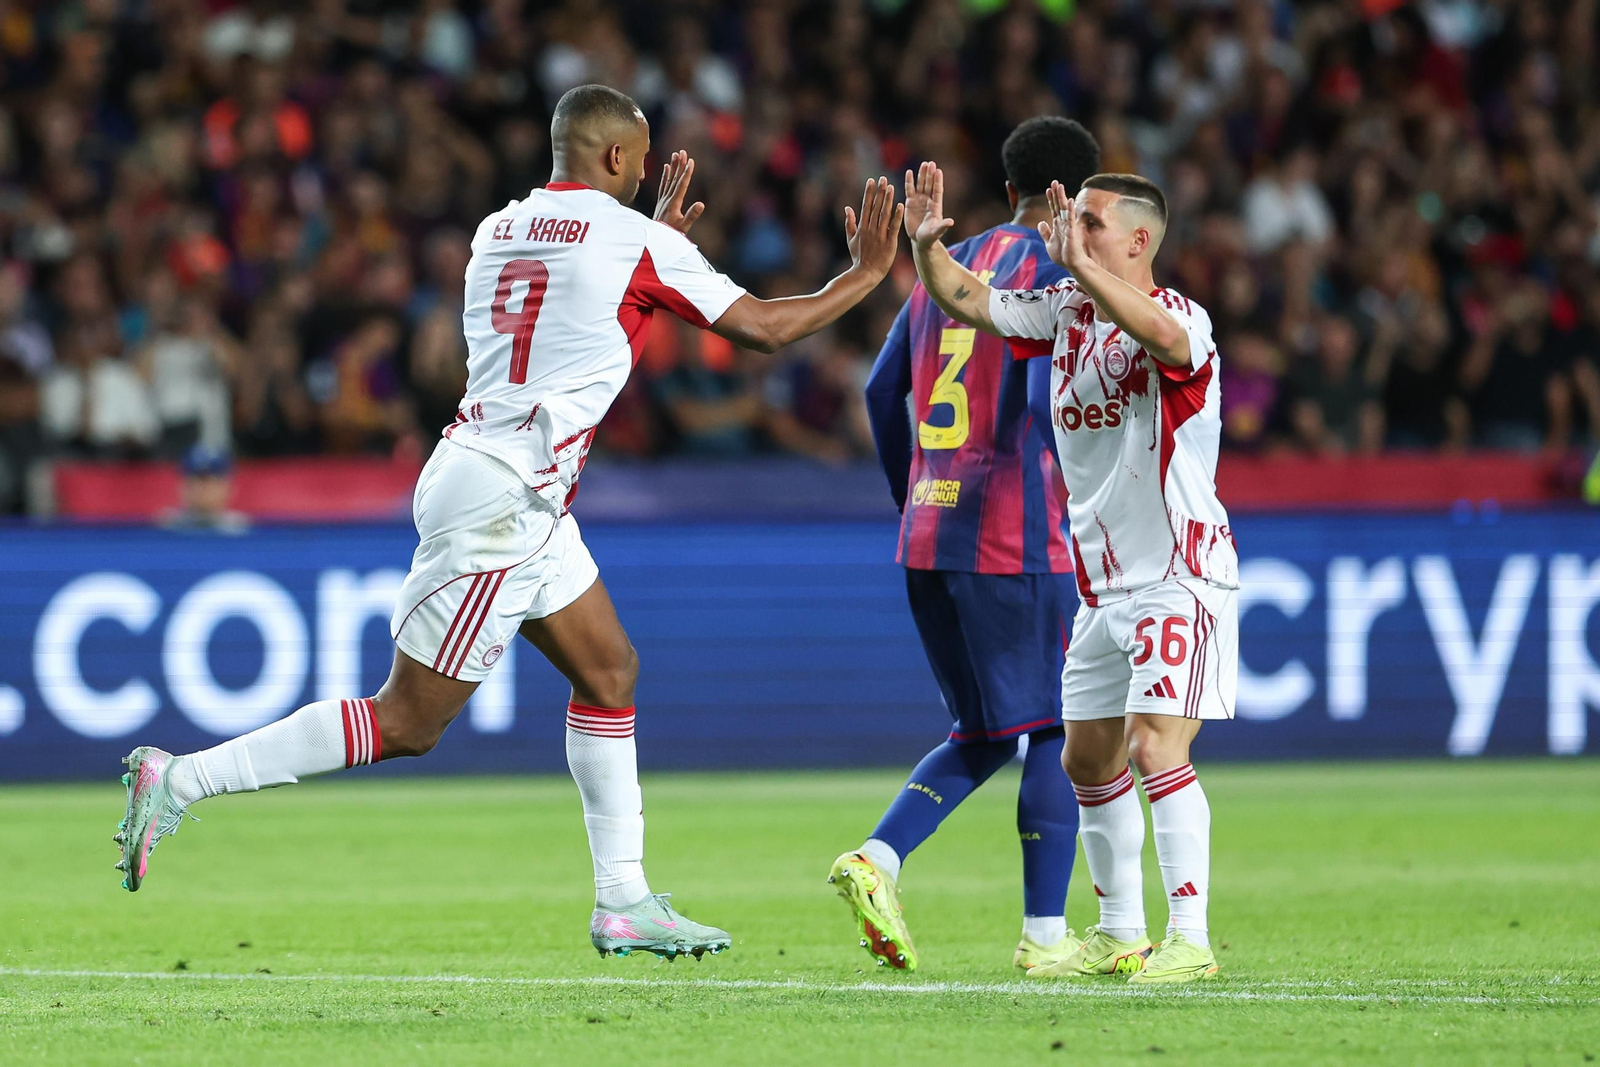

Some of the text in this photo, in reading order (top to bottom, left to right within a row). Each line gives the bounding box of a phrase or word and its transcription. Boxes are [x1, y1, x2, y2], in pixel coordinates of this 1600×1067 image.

[492, 217, 590, 244] EL KAABI
[491, 259, 550, 385] 9
[918, 328, 977, 450] 3
[1133, 615, 1188, 667] 56
